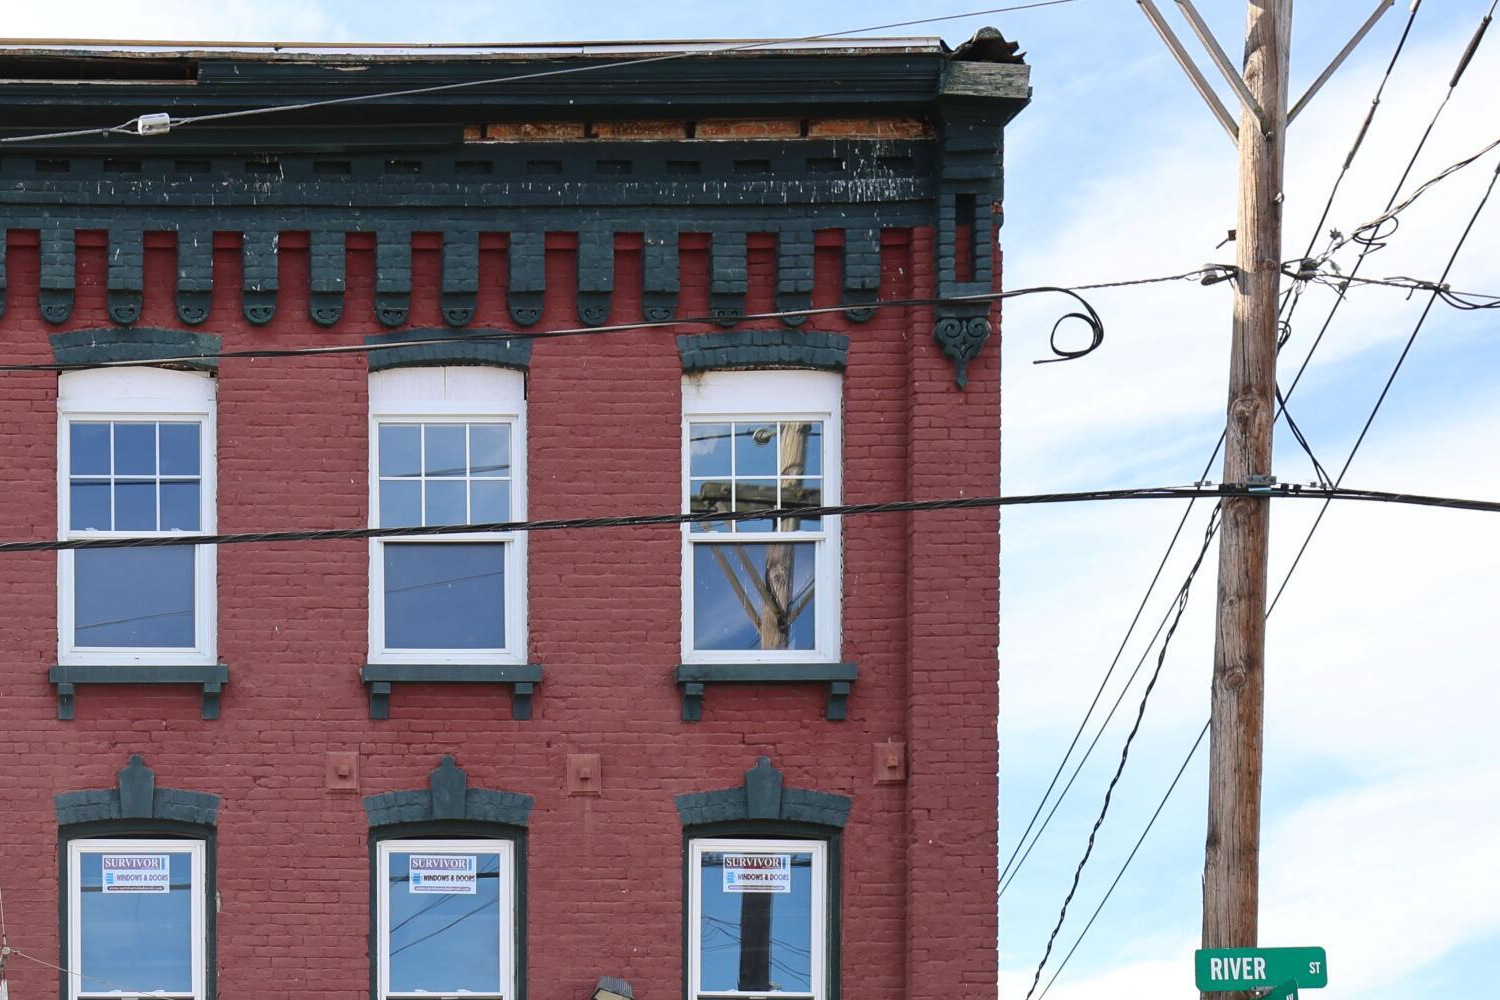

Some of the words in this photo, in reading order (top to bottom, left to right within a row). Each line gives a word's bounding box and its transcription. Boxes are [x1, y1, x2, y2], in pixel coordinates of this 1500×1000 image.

[105, 858, 158, 867] SURVIVOR
[412, 859, 466, 868] SURVIVOR
[726, 857, 780, 867] SURVIVOR
[1210, 957, 1267, 980] RIVER
[1309, 961, 1321, 974] ST
